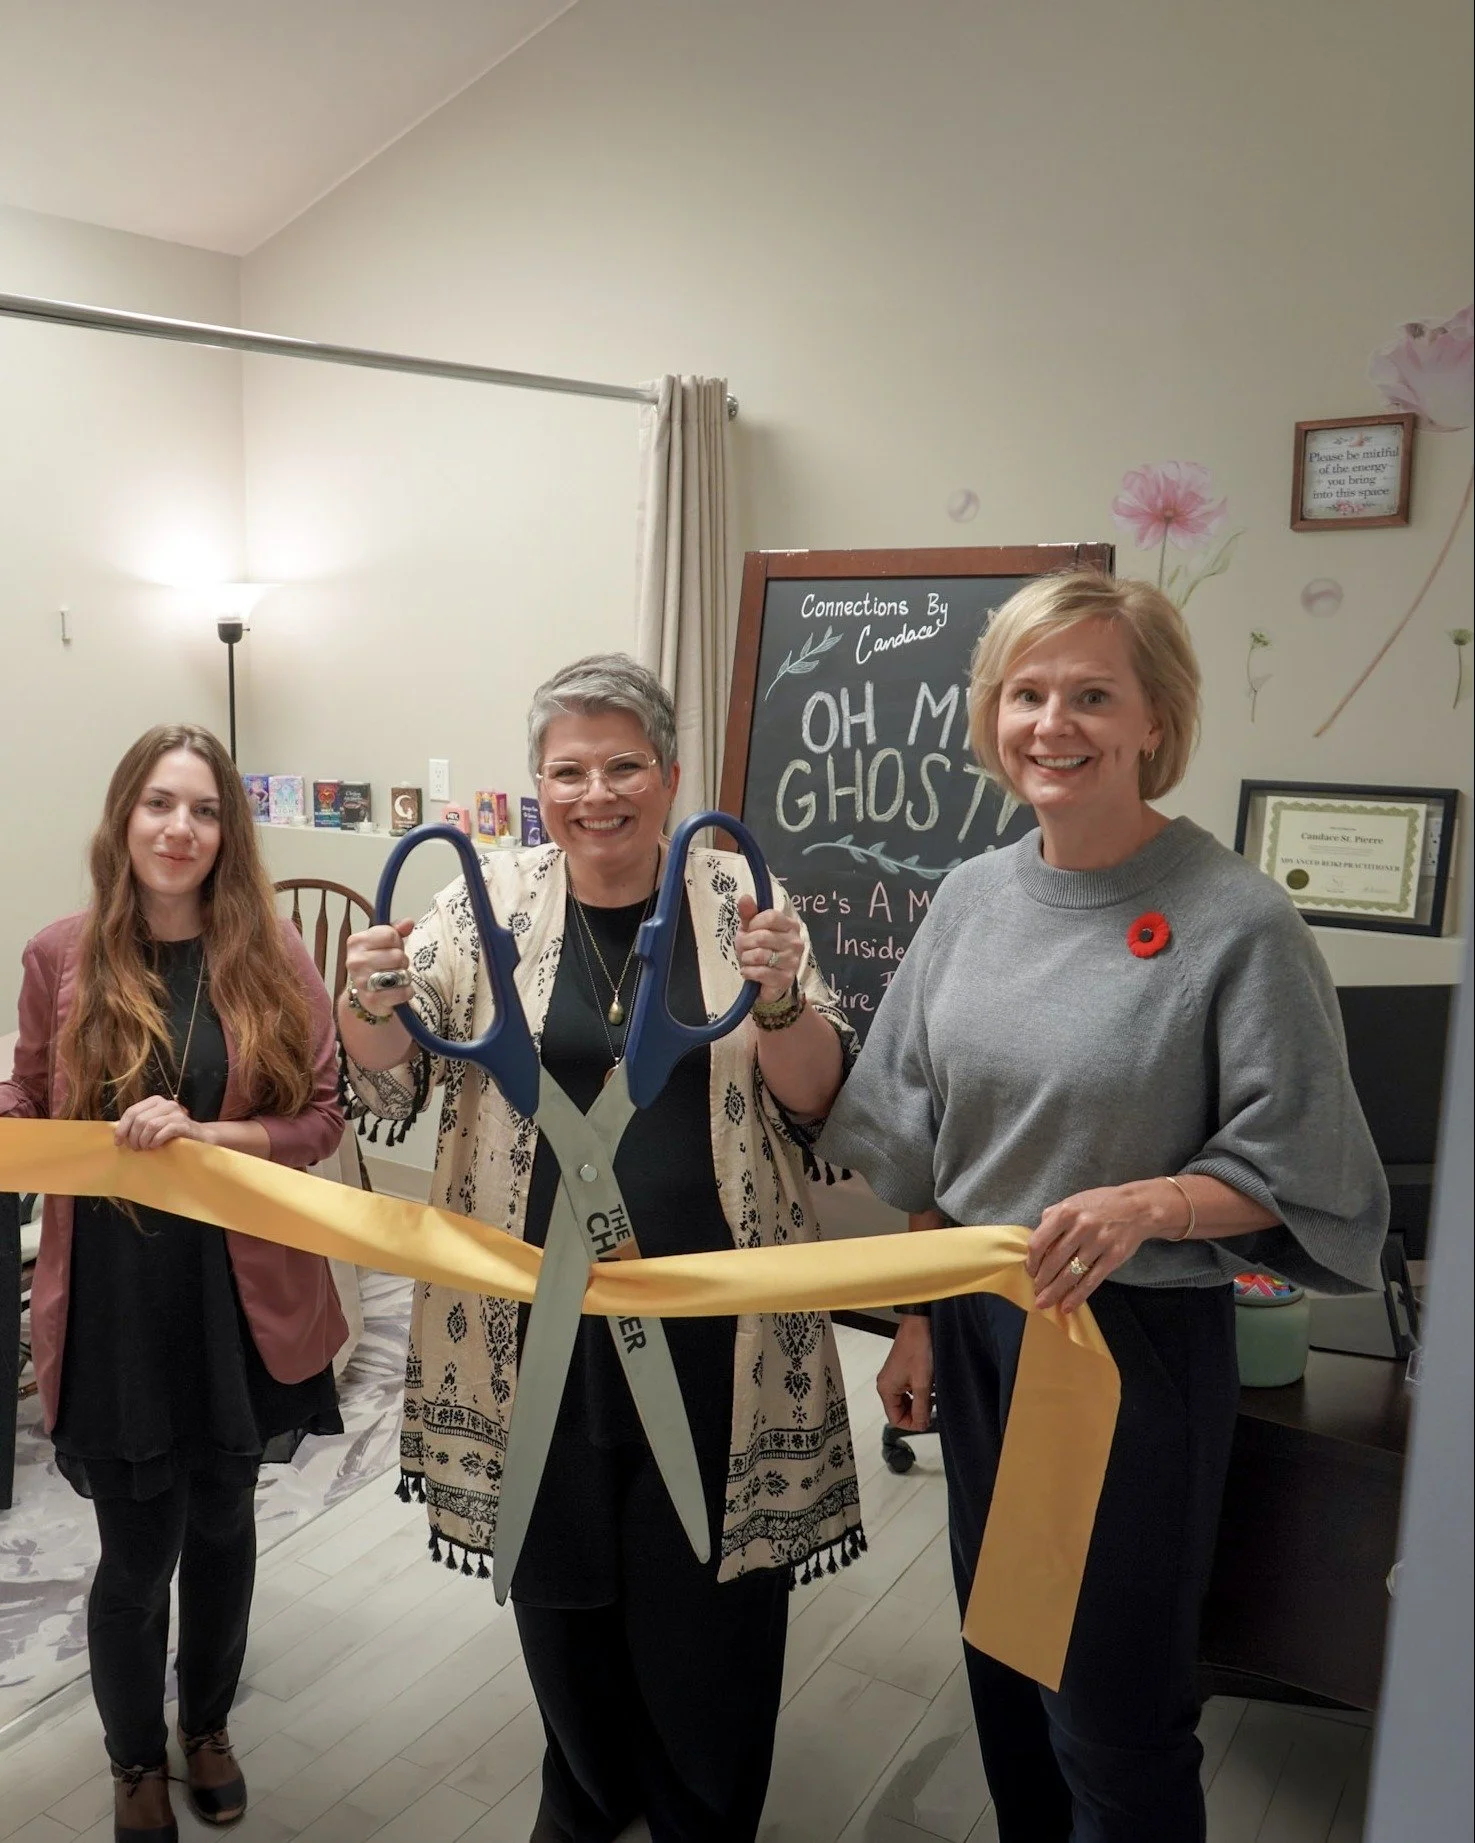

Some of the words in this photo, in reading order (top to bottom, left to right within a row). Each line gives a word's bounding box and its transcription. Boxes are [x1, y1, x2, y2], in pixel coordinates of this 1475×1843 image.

[1309, 451, 1344, 463] Please
[1346, 450, 1359, 461] be
[1363, 446, 1400, 459] mindful
[1319, 463, 1330, 475] of
[1332, 463, 1349, 474] the
[1352, 463, 1388, 474] energy
[1313, 489, 1333, 500] into
[1336, 487, 1356, 499] this
[1358, 487, 1390, 500] space
[1327, 478, 1346, 489] you
[1348, 475, 1378, 486] bring
[801, 592, 910, 619] Connections
[926, 592, 949, 627] By
[855, 622, 940, 666] Candace
[801, 680, 877, 755] OH
[775, 746, 1021, 843] GHOST
[1300, 832, 1340, 842] Candace
[1354, 836, 1384, 845] Pierre
[869, 880, 893, 923] A
[836, 922, 905, 961] Inside
[608, 1203, 632, 1243] THE
